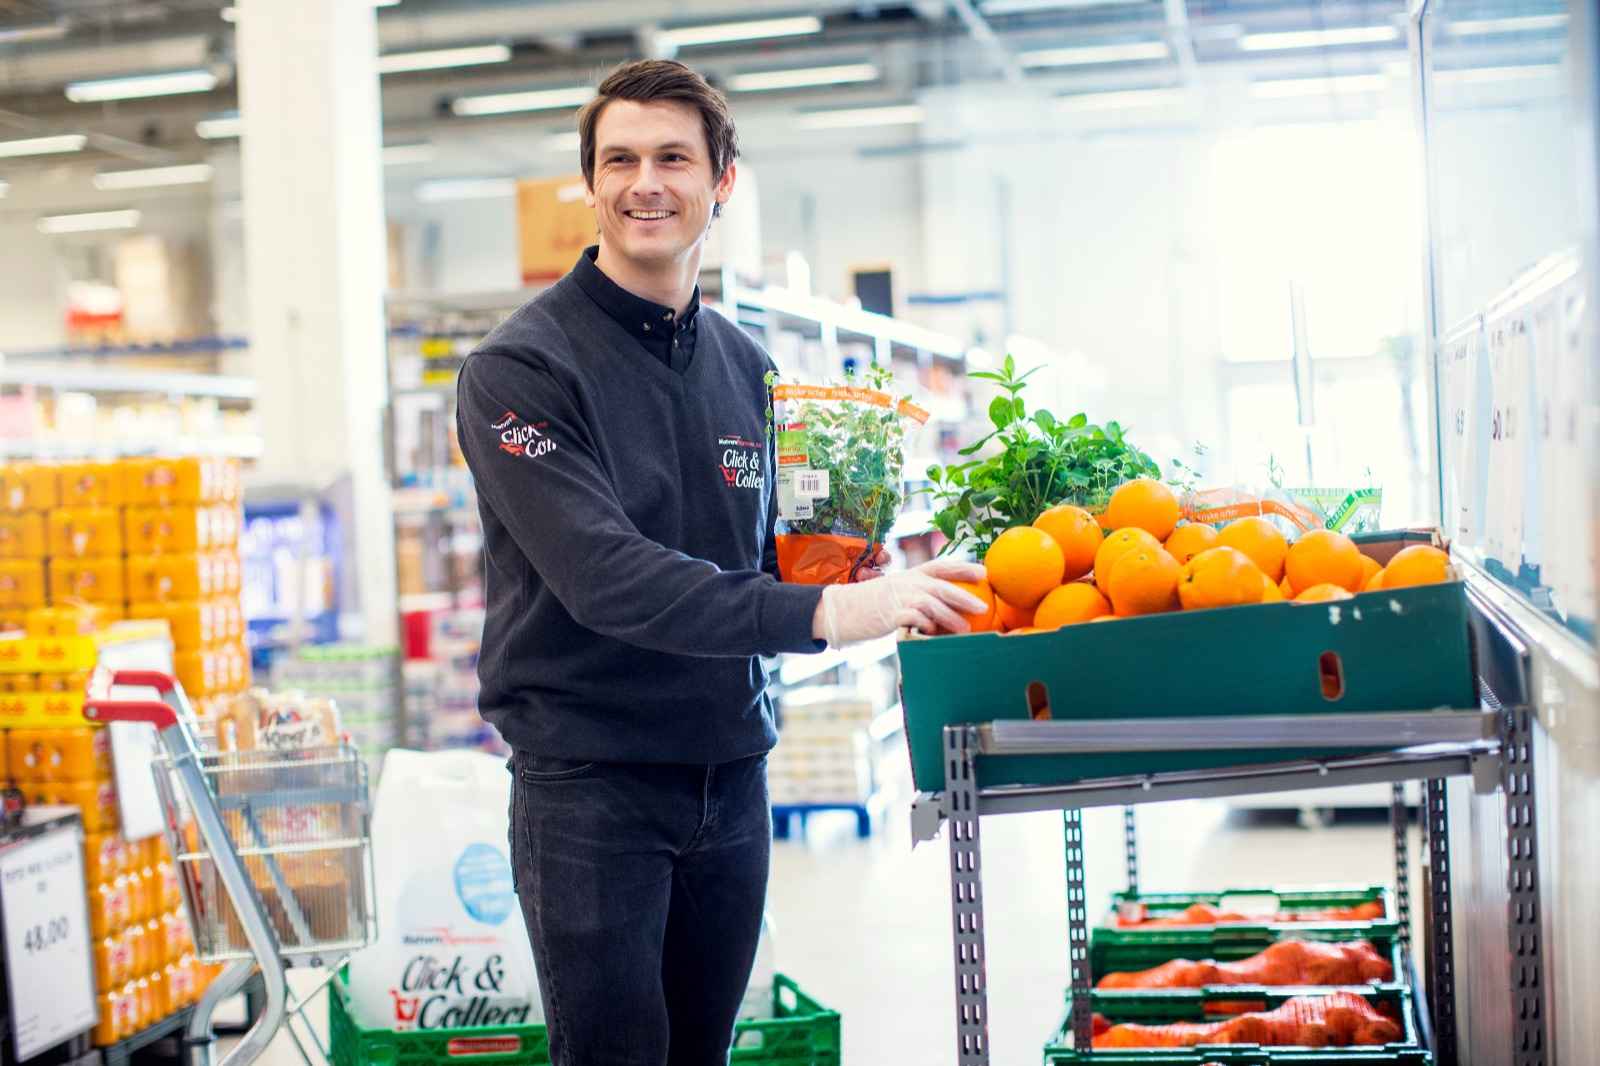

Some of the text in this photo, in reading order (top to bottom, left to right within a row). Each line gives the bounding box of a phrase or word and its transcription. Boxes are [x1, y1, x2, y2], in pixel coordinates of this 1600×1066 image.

[722, 448, 748, 471] Click
[750, 451, 760, 471] &
[735, 468, 764, 489] Collec
[402, 954, 504, 995] Click &
